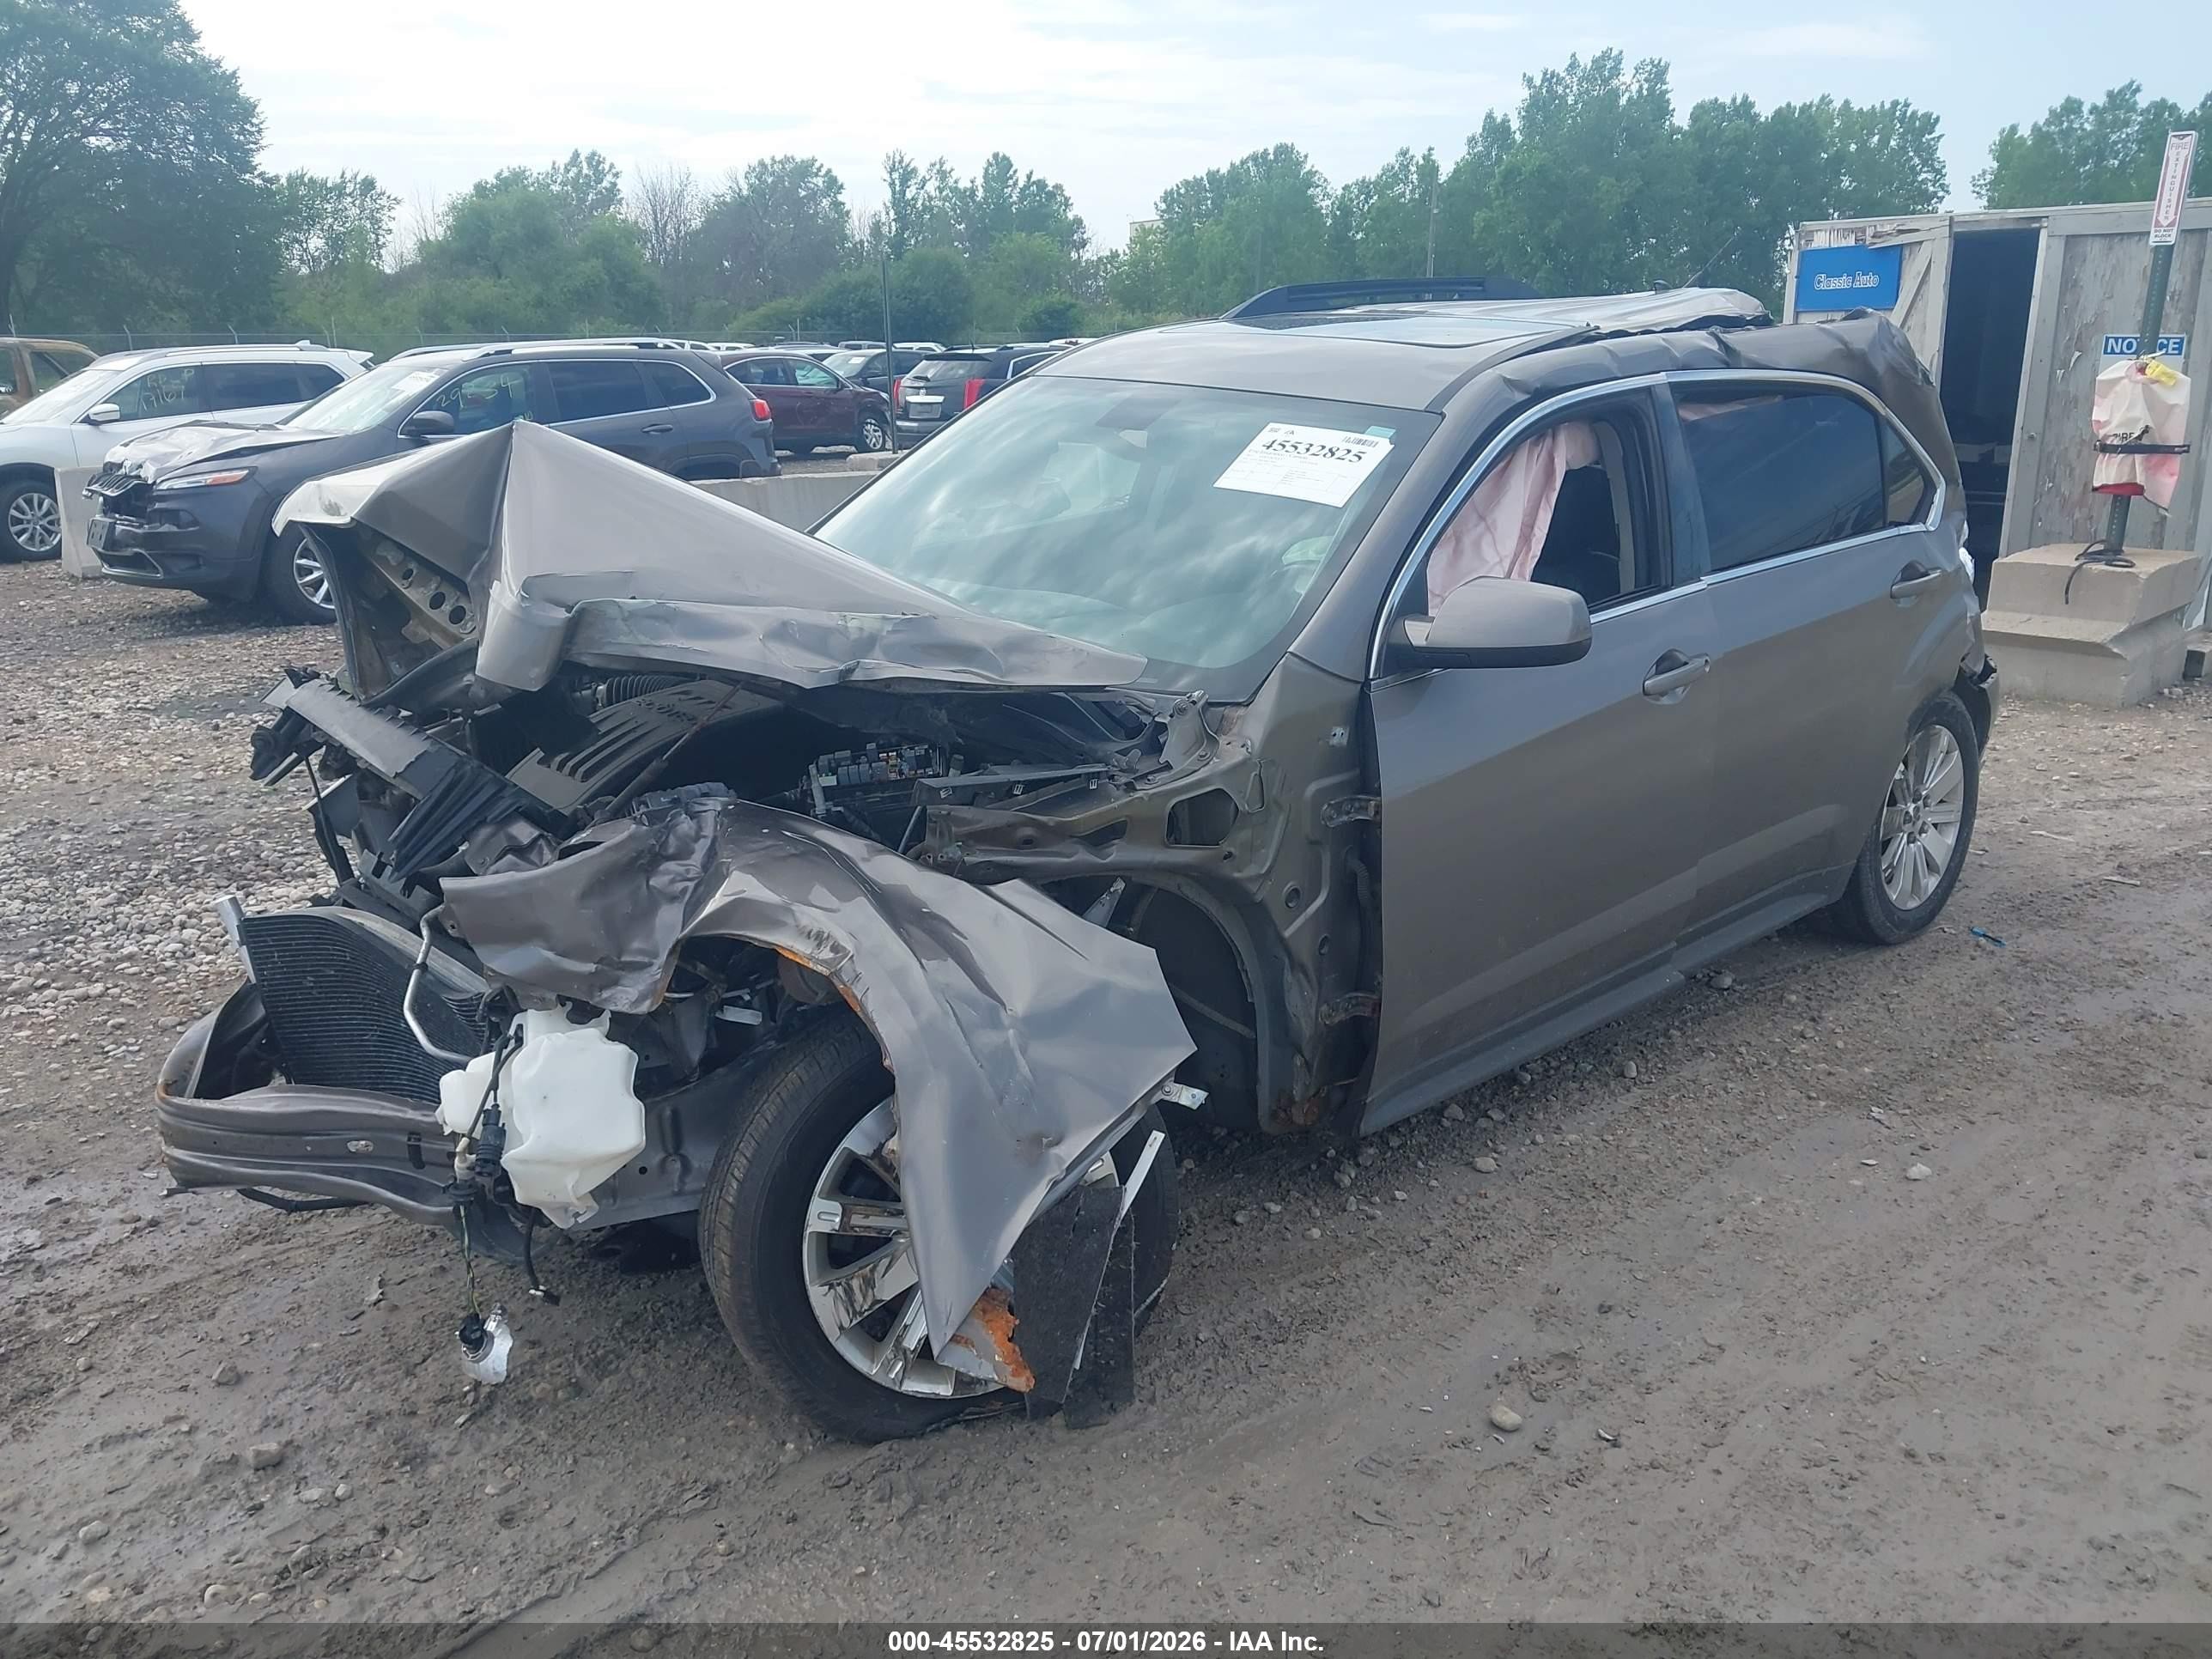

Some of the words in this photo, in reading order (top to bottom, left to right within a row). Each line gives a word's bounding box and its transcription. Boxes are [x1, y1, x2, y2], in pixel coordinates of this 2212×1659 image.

[1814, 273, 1852, 289] Classic
[1853, 270, 1880, 289] Auto
[2106, 337, 2181, 354] NOCE
[1261, 439, 1368, 463] 45532825
